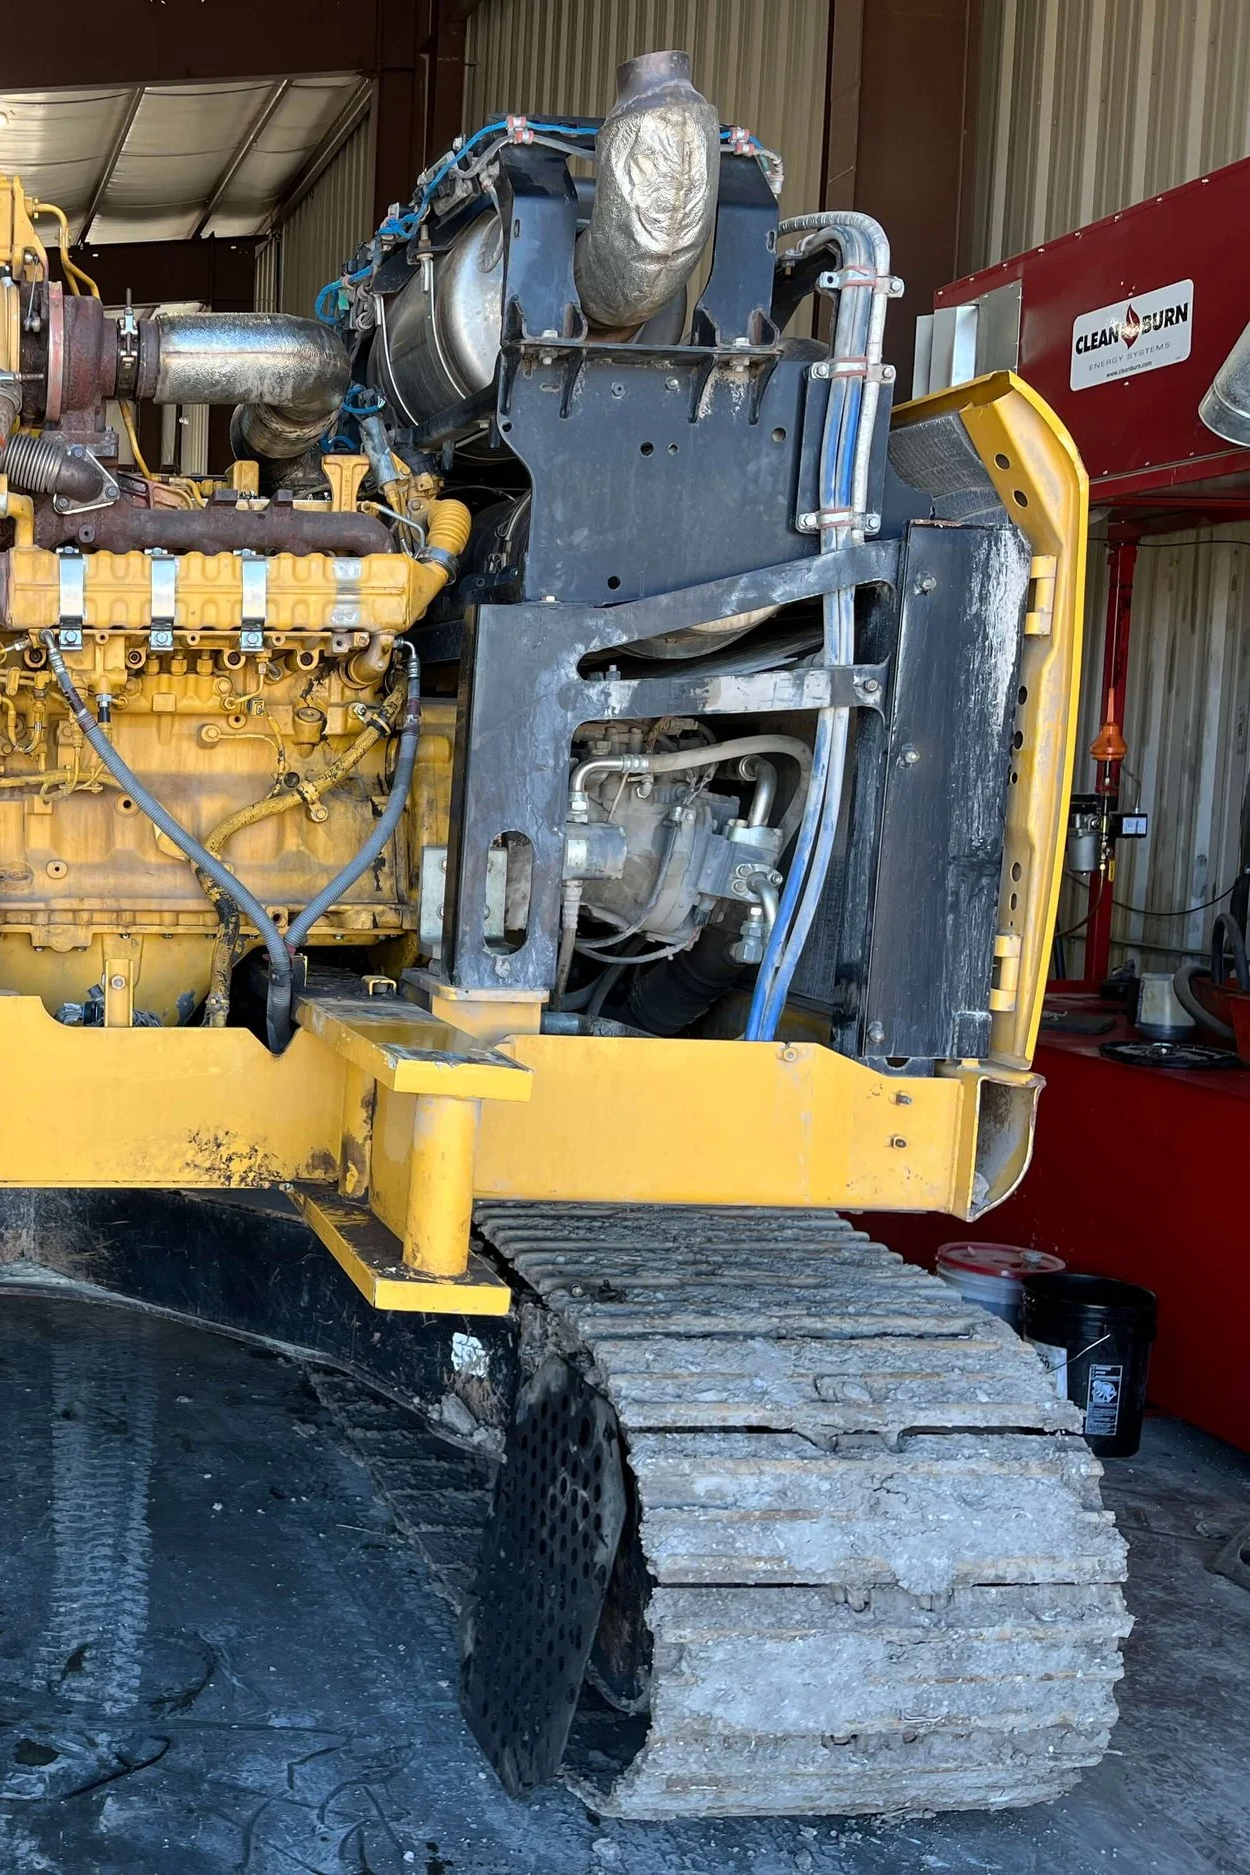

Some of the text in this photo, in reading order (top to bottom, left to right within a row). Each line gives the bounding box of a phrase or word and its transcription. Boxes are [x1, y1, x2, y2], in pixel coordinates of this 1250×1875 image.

[1076, 302, 1188, 354] CLEAN BURN
[1089, 341, 1171, 371] ENERGY SYSTEMS
